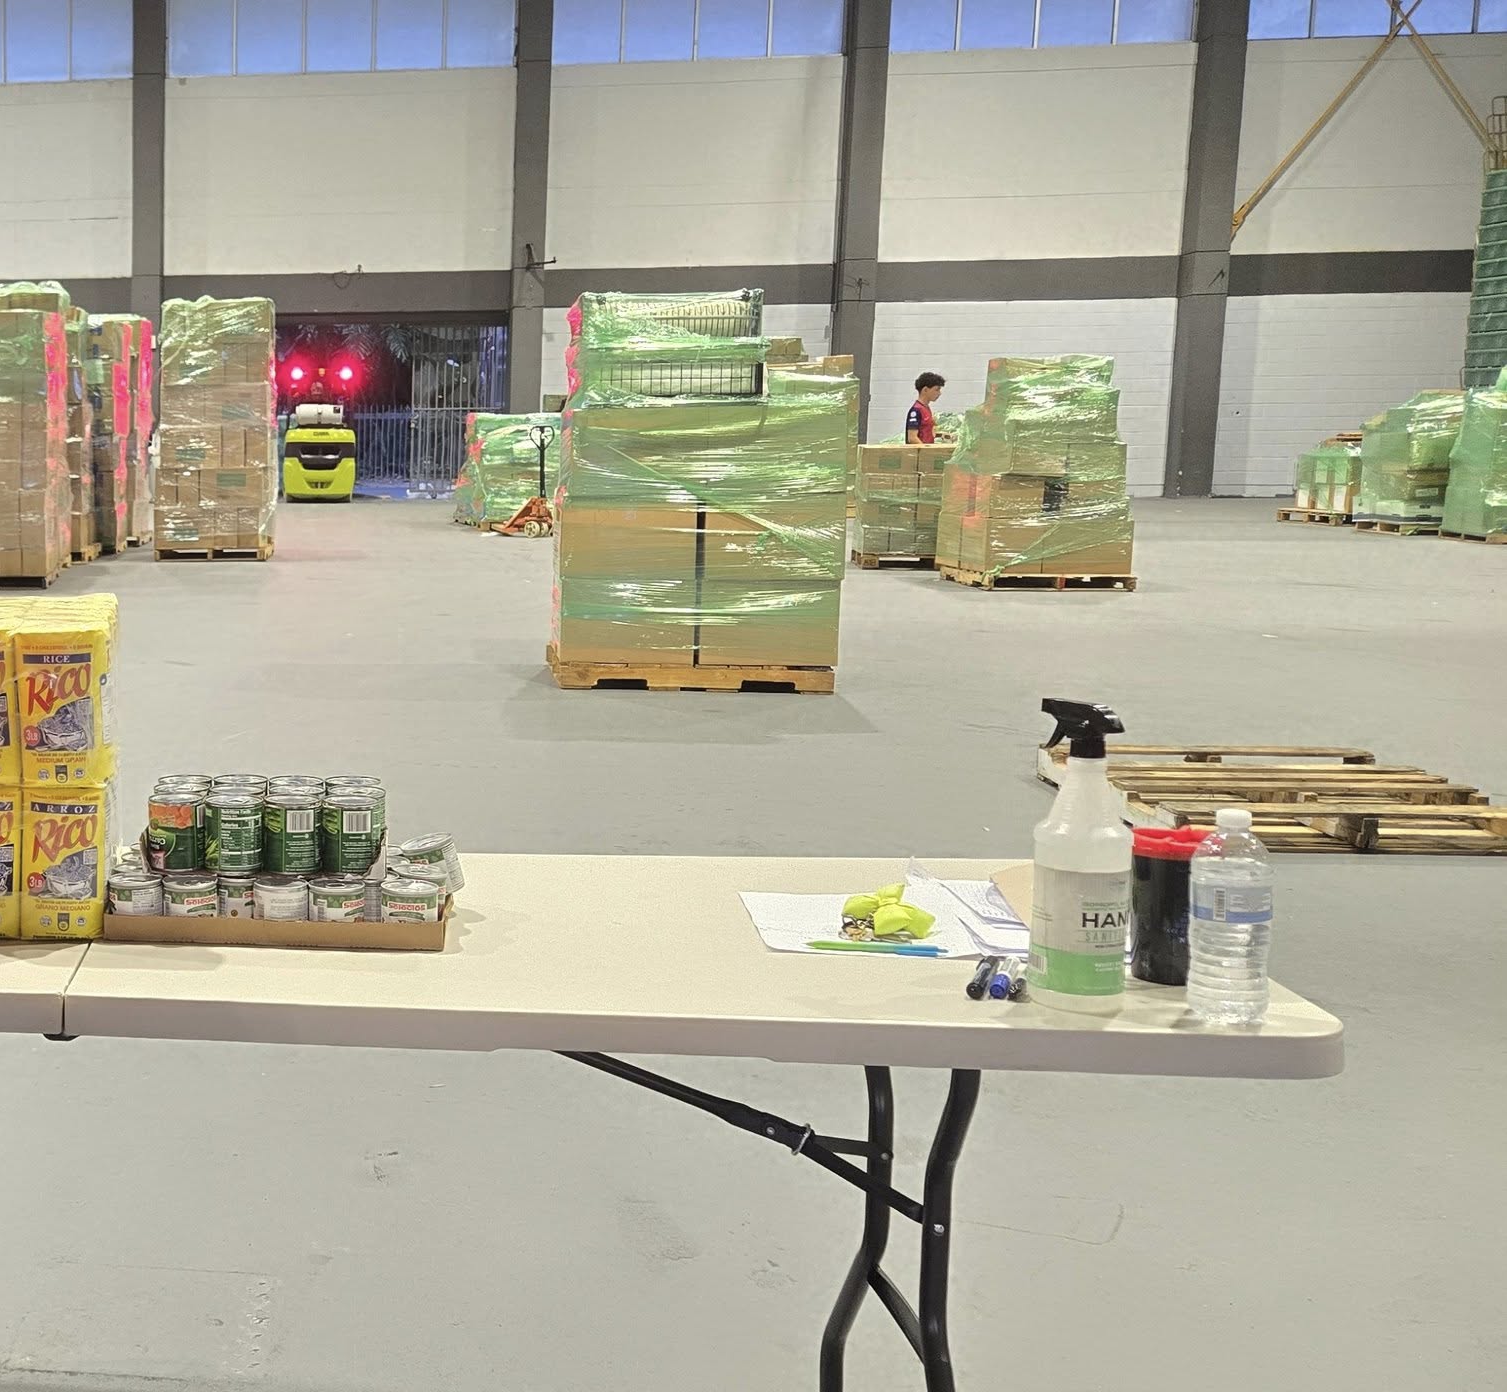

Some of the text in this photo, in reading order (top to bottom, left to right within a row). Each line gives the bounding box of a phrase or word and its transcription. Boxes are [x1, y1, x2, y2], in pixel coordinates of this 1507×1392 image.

[43, 655, 70, 663] RICE
[25, 663, 91, 716] Rico
[33, 804, 96, 813] ARROZ
[31, 814, 98, 863] Rico
[1082, 911, 1128, 928] HAN
